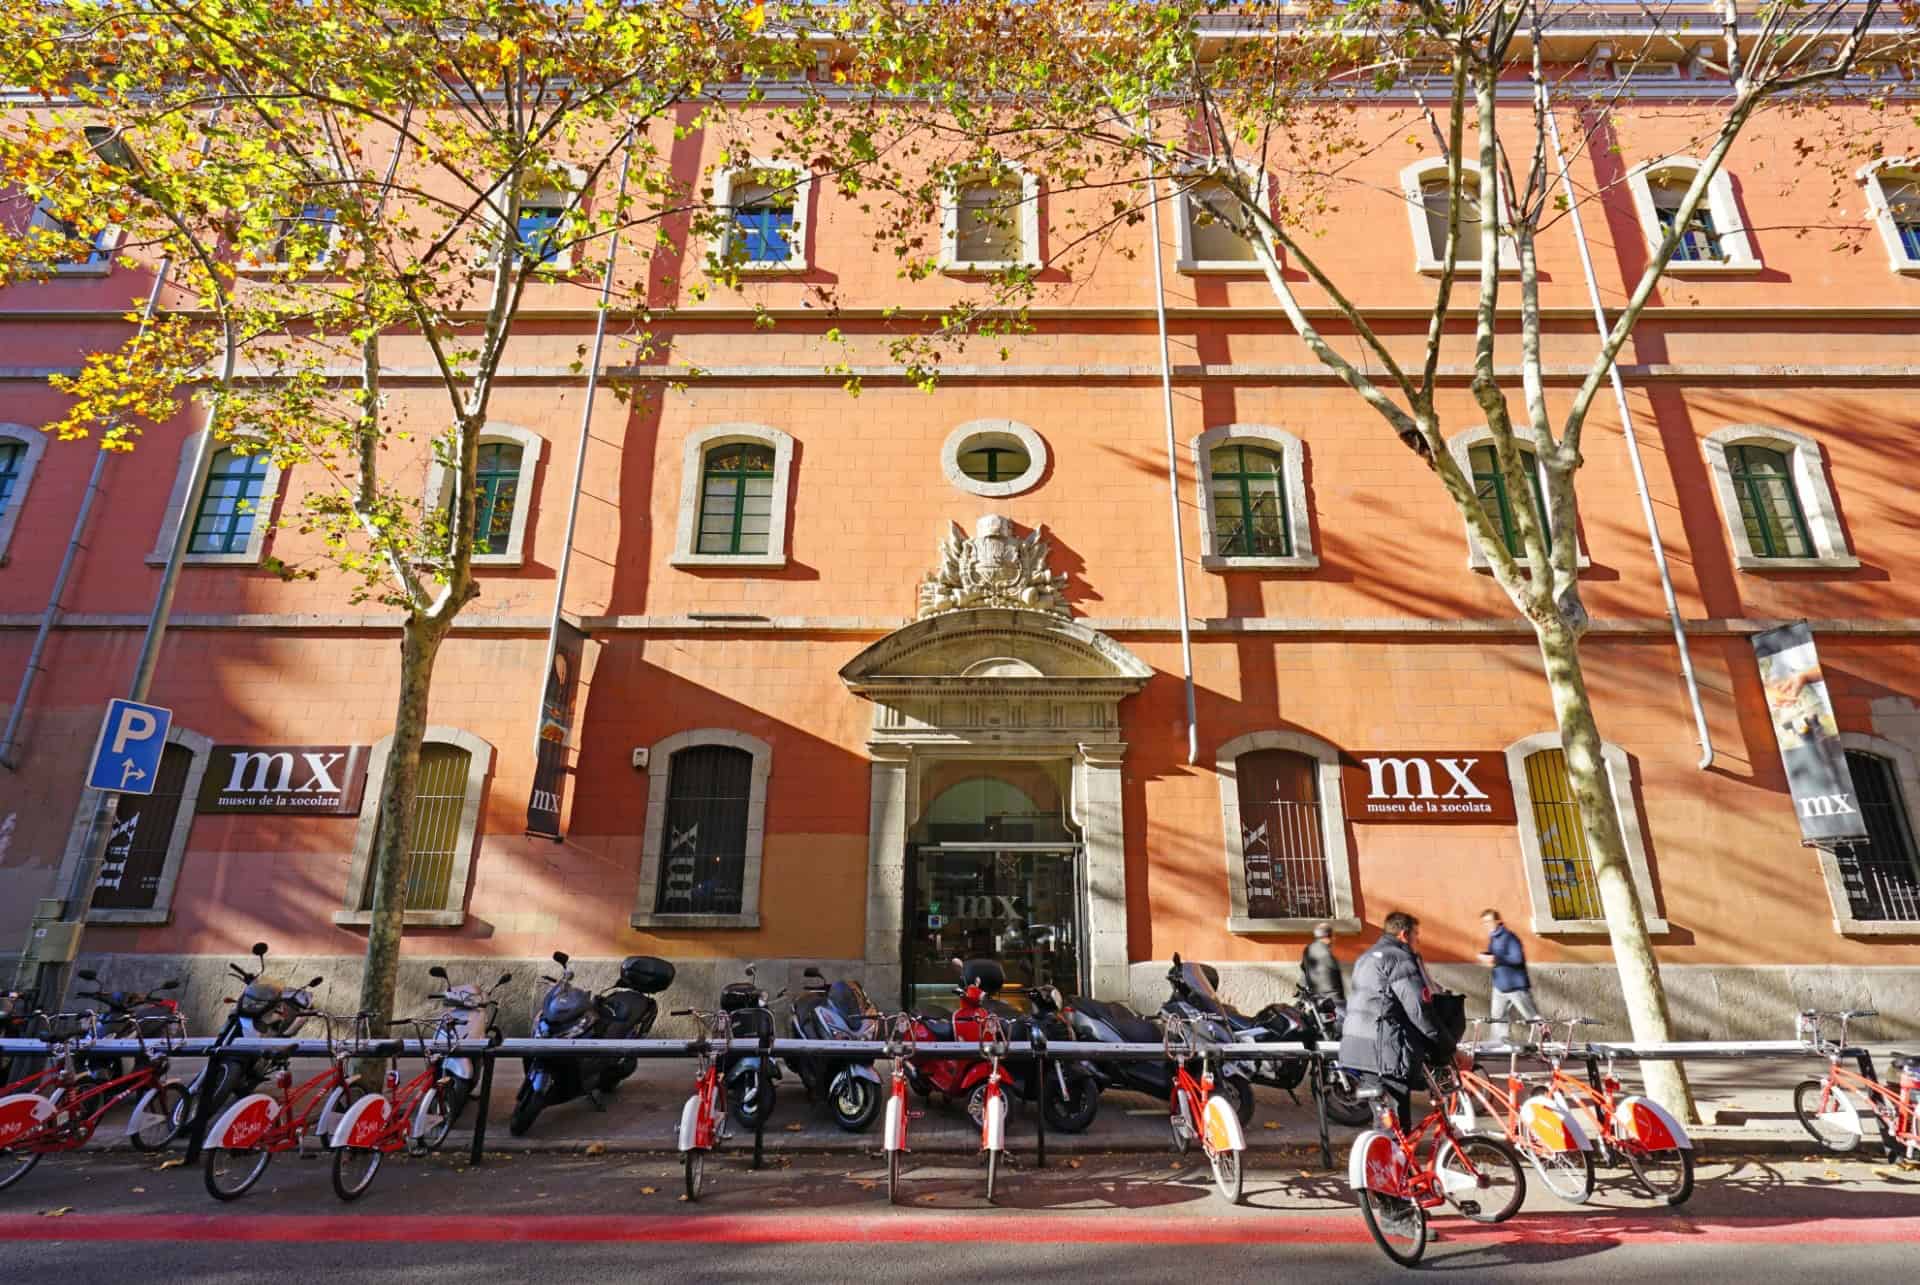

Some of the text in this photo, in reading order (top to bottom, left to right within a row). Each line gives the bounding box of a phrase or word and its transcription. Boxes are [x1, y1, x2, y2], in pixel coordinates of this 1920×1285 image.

[111, 708, 156, 753] P
[222, 751, 344, 793] mx
[1361, 757, 1489, 799] mx
[217, 795, 340, 806] museu de la xocolata
[531, 789, 560, 814] mx
[1367, 801, 1492, 812] museu de la xocolata
[1798, 793, 1857, 817] mx
[666, 821, 699, 899] mx
[1242, 819, 1275, 900] mx
[954, 895, 1025, 920] mx
